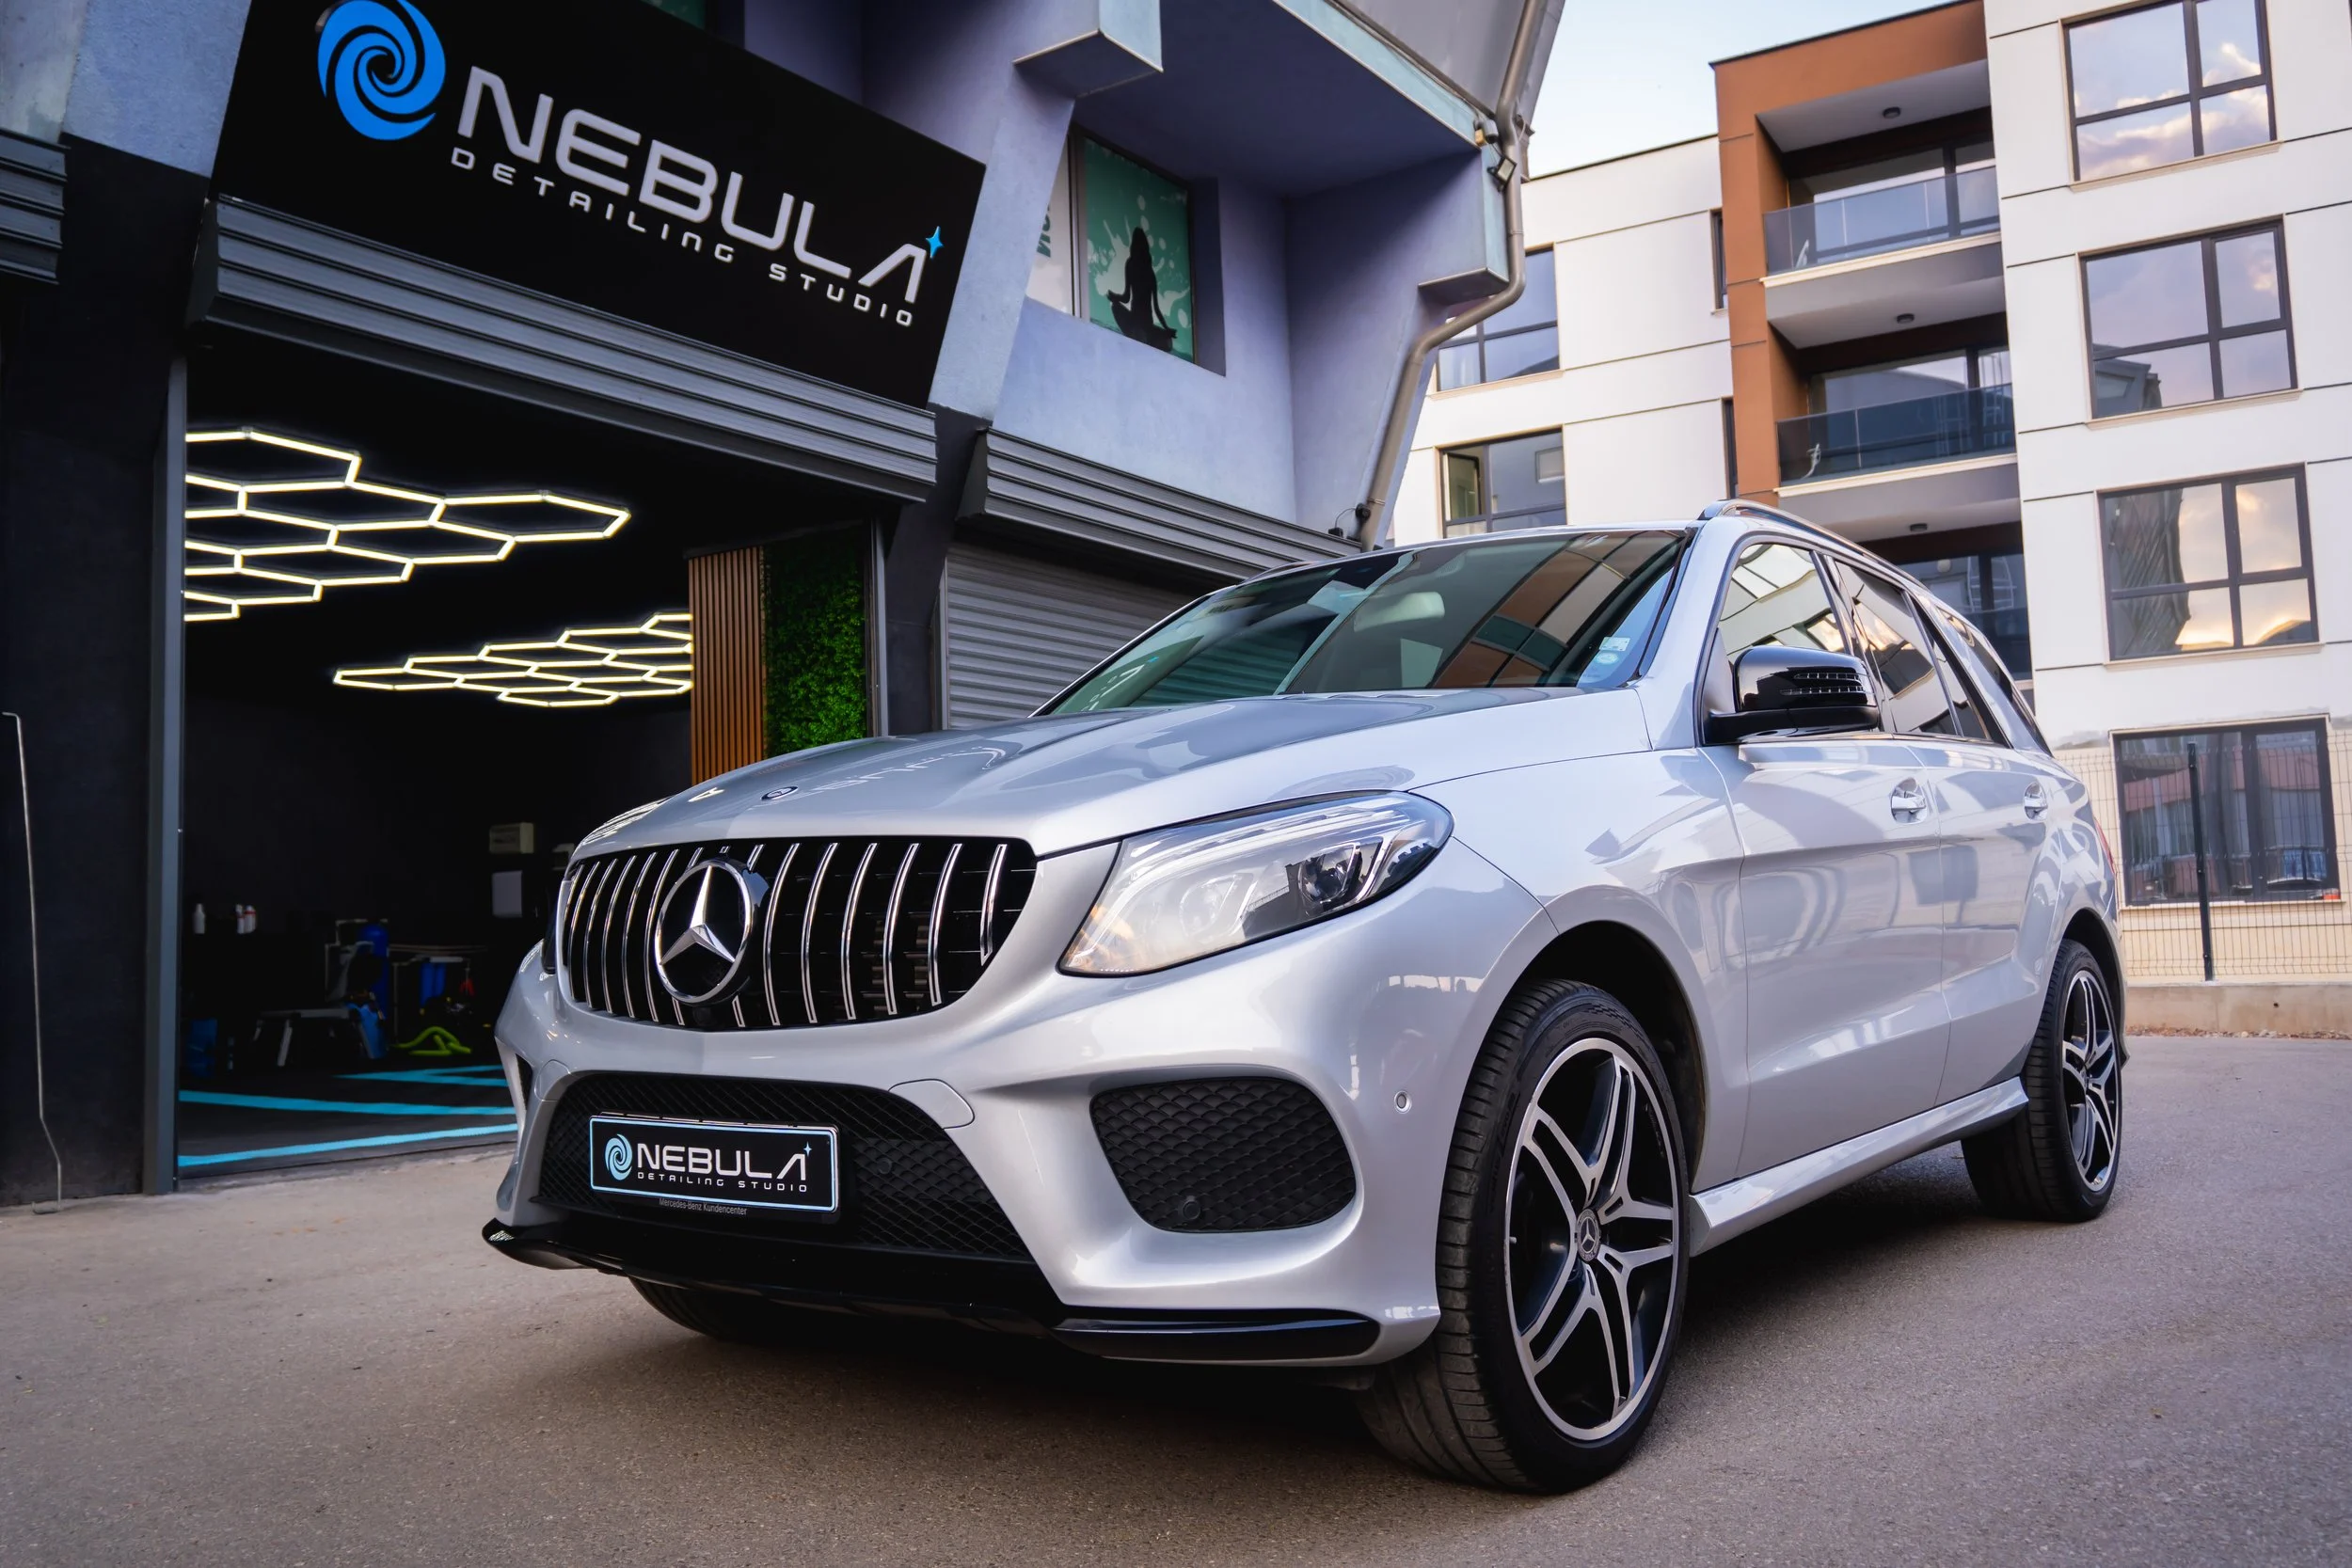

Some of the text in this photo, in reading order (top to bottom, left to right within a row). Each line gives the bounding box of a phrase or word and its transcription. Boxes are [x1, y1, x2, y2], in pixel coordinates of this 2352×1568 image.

[458, 67, 928, 304] NEBULA
[451, 147, 913, 327] DETAILING STUDIO
[637, 1143, 806, 1181] NEBULA
[637, 1171, 807, 1193] DETAILING STUDIO
[659, 1197, 747, 1215] Mercedes-Benz Kundencenter
